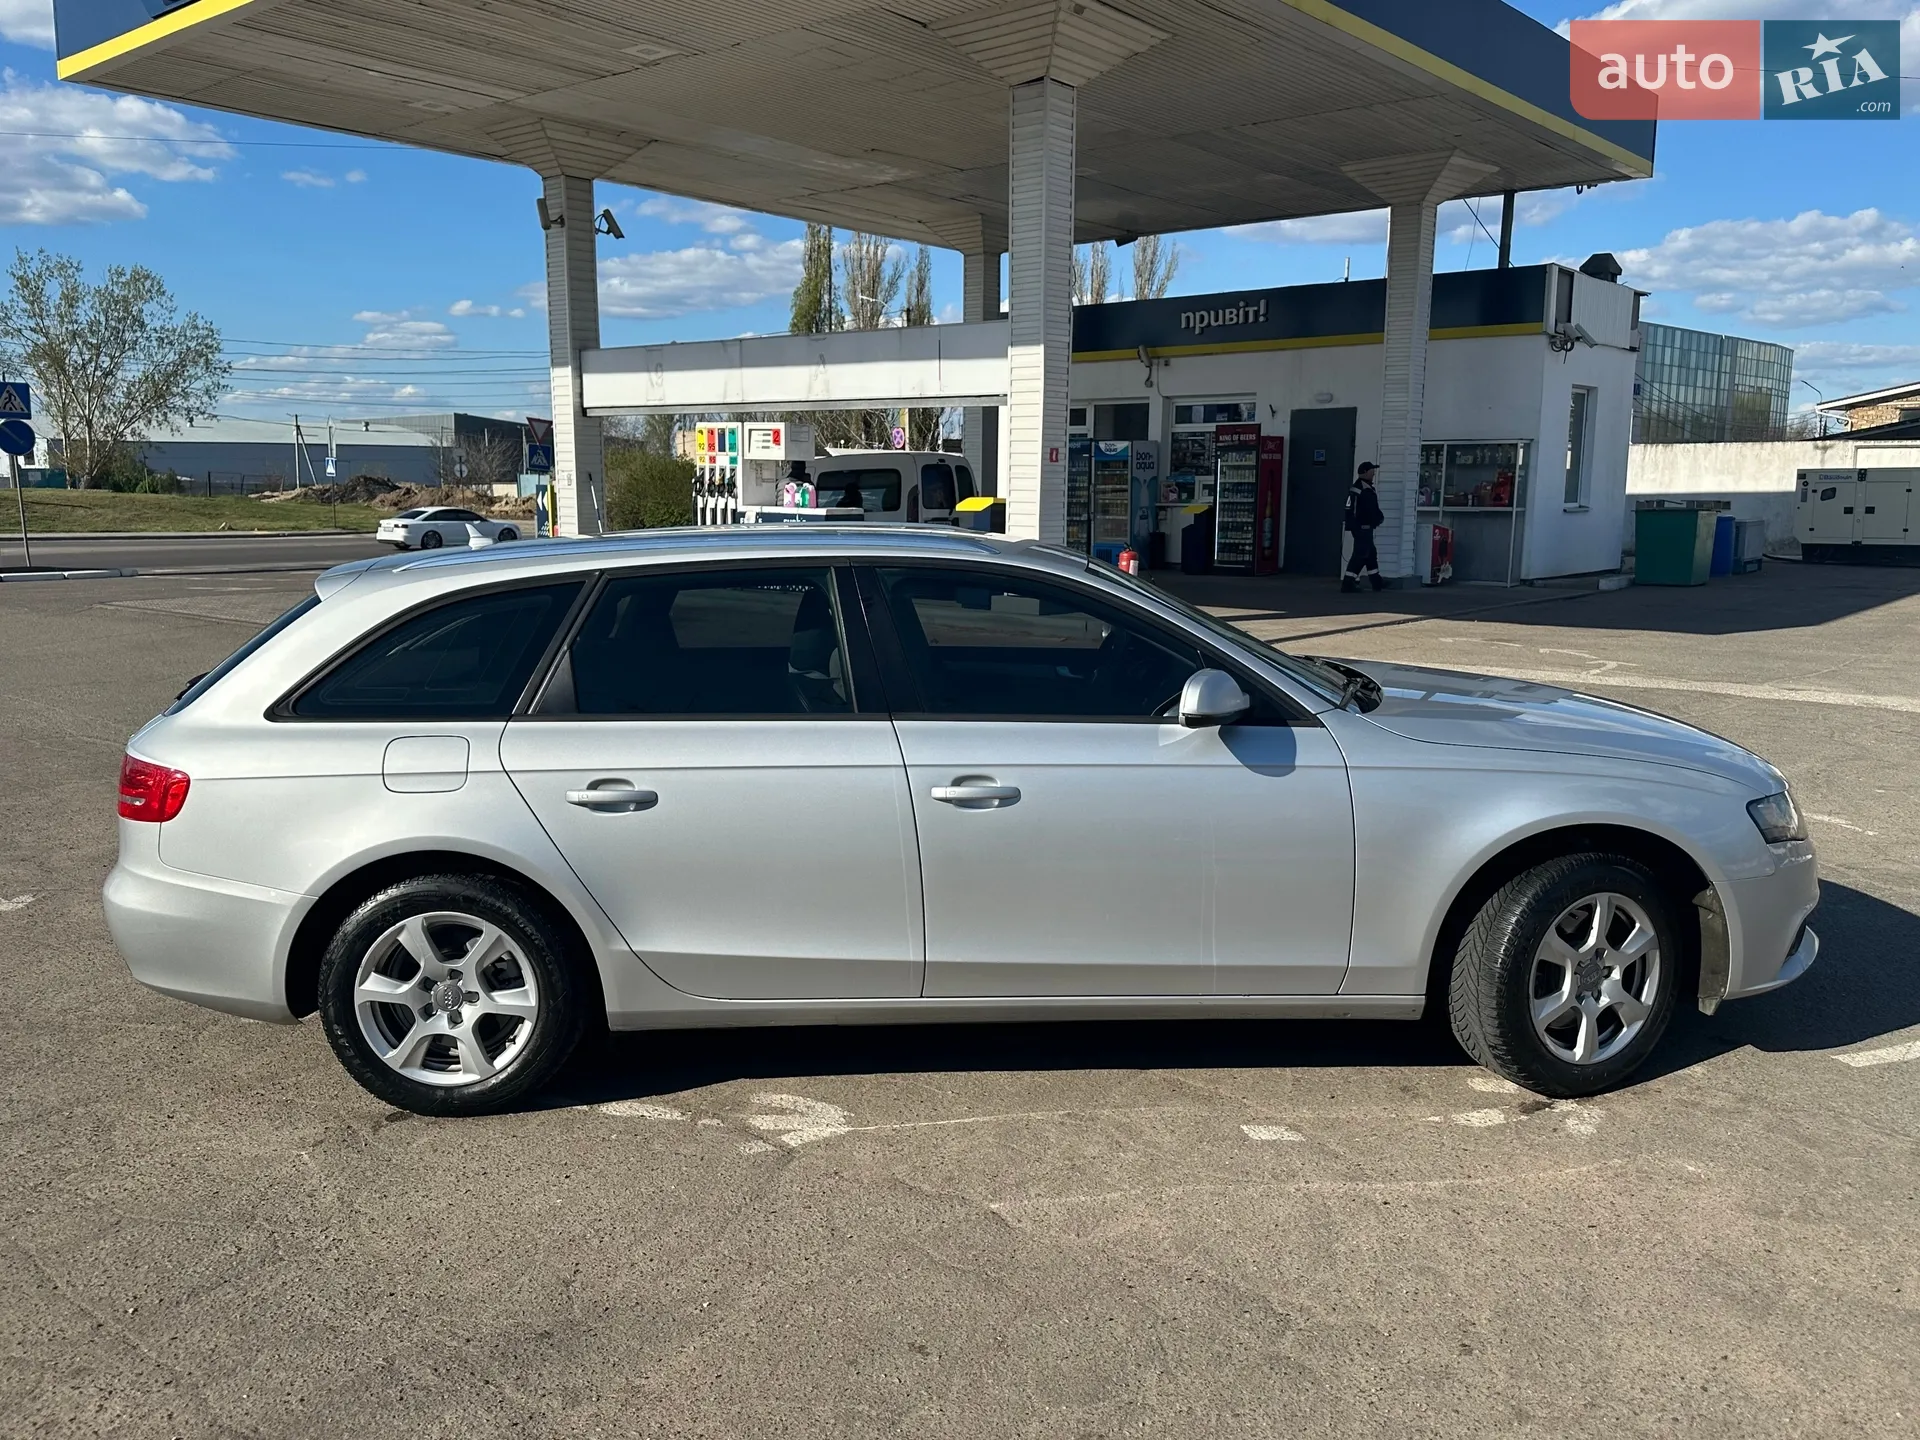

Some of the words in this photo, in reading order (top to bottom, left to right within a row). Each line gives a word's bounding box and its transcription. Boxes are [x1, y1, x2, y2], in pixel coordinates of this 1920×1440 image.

[1181, 299, 1267, 335] привіт!
[1240, 433, 1257, 441] BEERS
[1136, 450, 1154, 461] bon-
[1136, 461, 1155, 472] aqua
